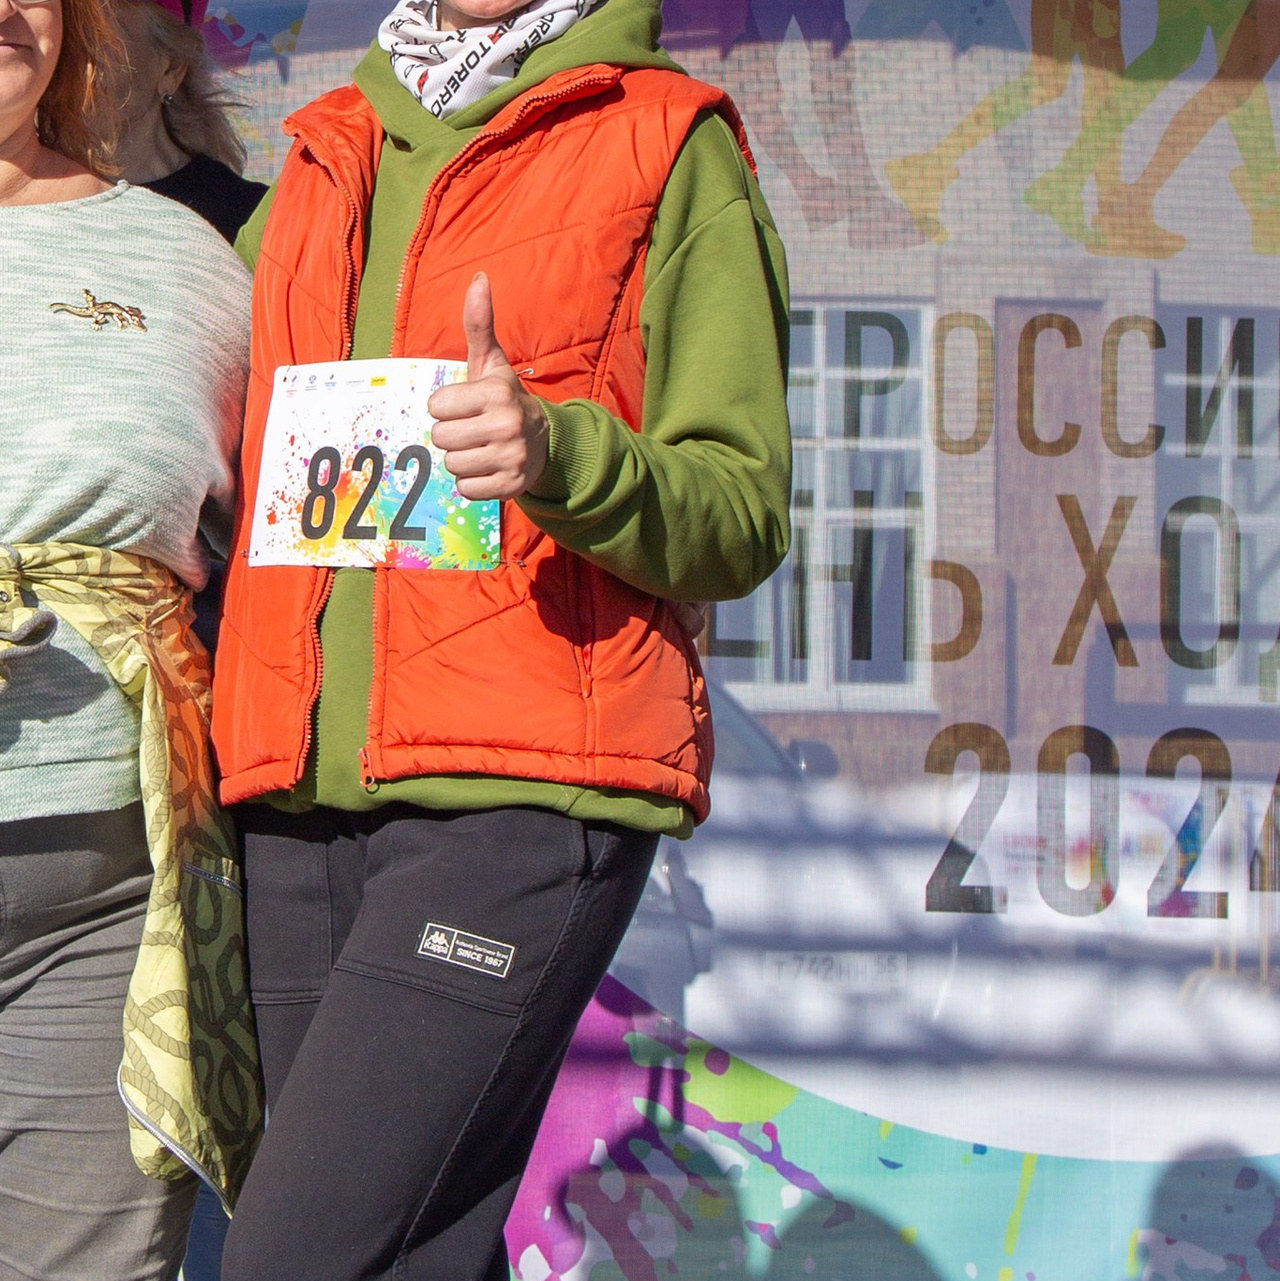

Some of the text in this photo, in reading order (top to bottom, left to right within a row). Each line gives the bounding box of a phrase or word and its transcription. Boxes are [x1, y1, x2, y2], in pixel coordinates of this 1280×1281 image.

[430, 40, 492, 118] TORERO
[789, 309, 1280, 460] РОССИ
[300, 445, 432, 542] 822
[1051, 493, 1280, 702] ХО
[423, 940, 449, 955] Kappa
[456, 947, 483, 962] SINCE
[484, 955, 504, 968] 1967
